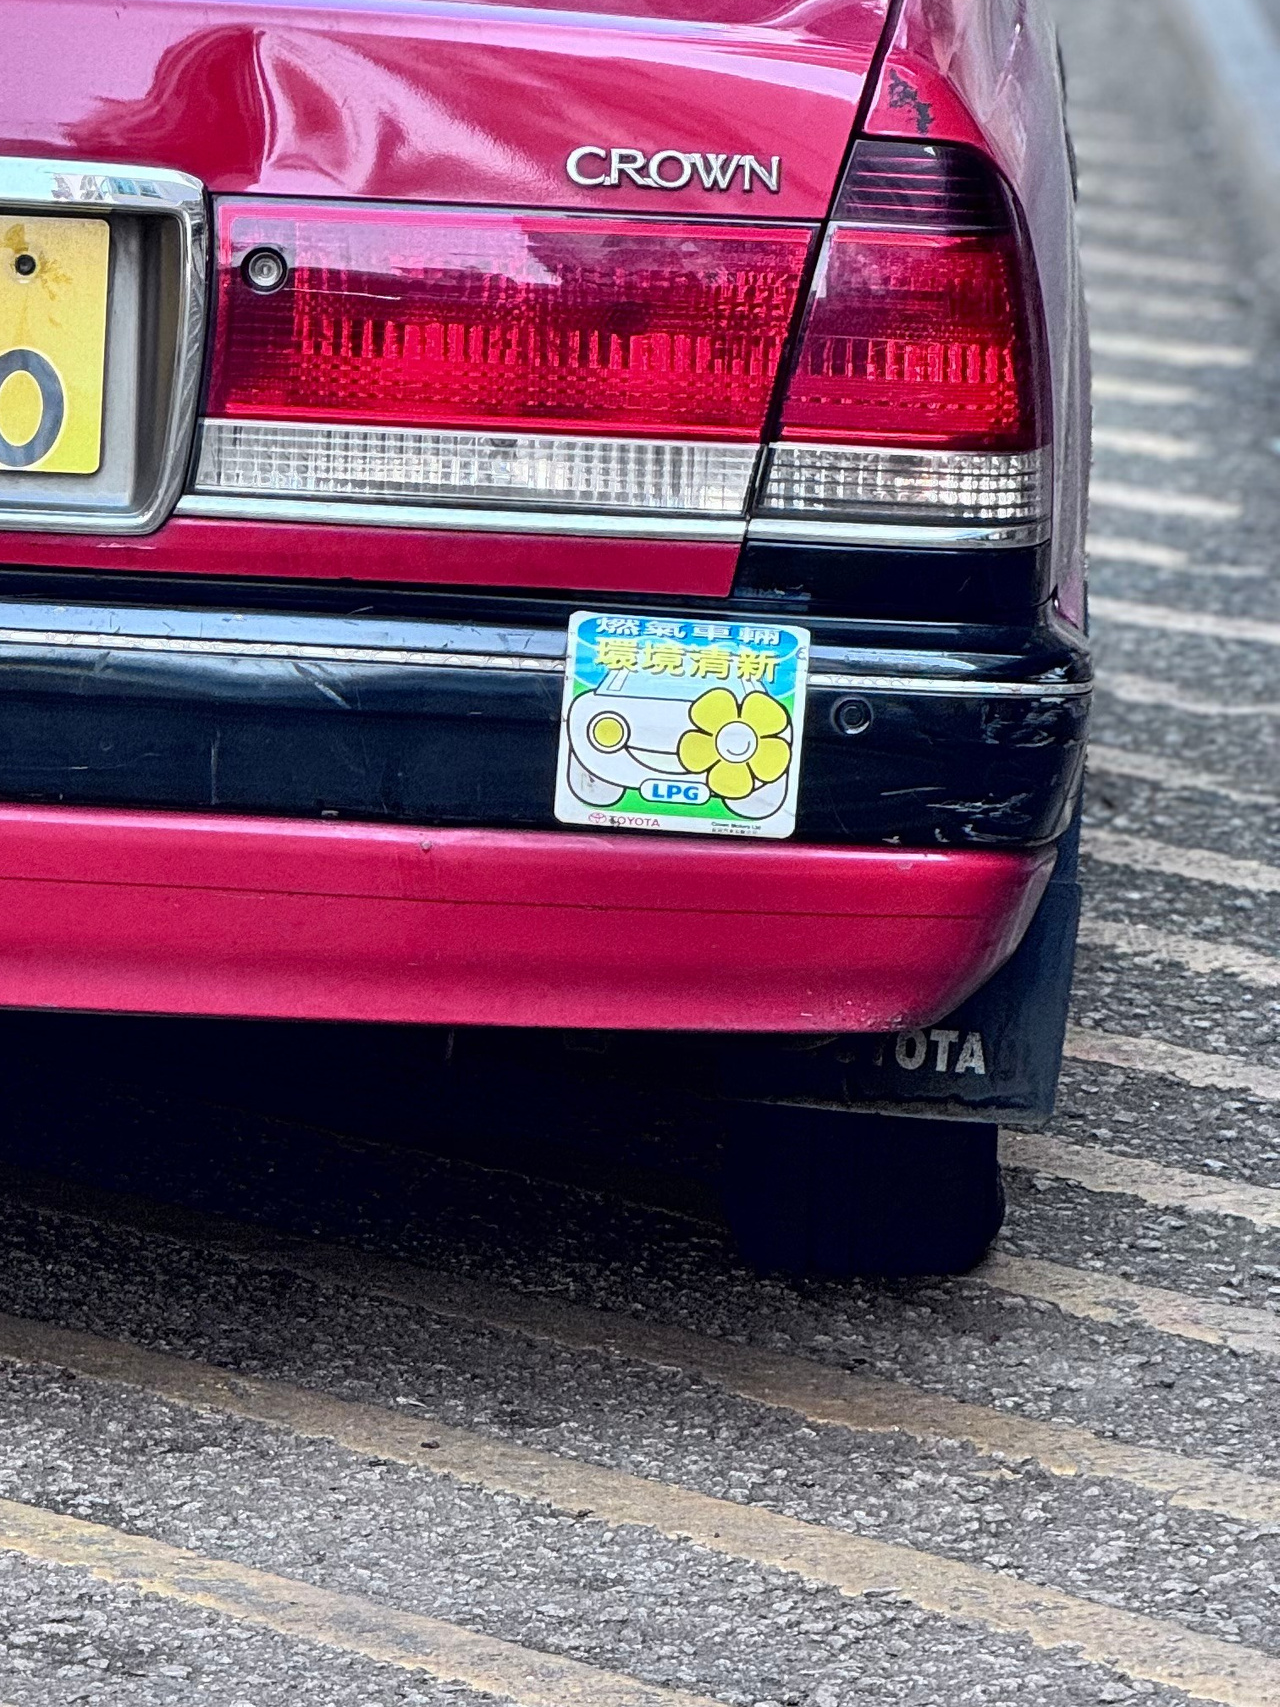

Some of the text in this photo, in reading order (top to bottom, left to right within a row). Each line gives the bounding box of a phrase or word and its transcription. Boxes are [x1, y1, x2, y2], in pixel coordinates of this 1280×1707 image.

[566, 146, 781, 192] CROWN
[595, 617, 781, 647] 燃氣車輛
[595, 637, 780, 683] 環境清新
[652, 783, 699, 802] LPG
[609, 815, 660, 827] TOYOTA
